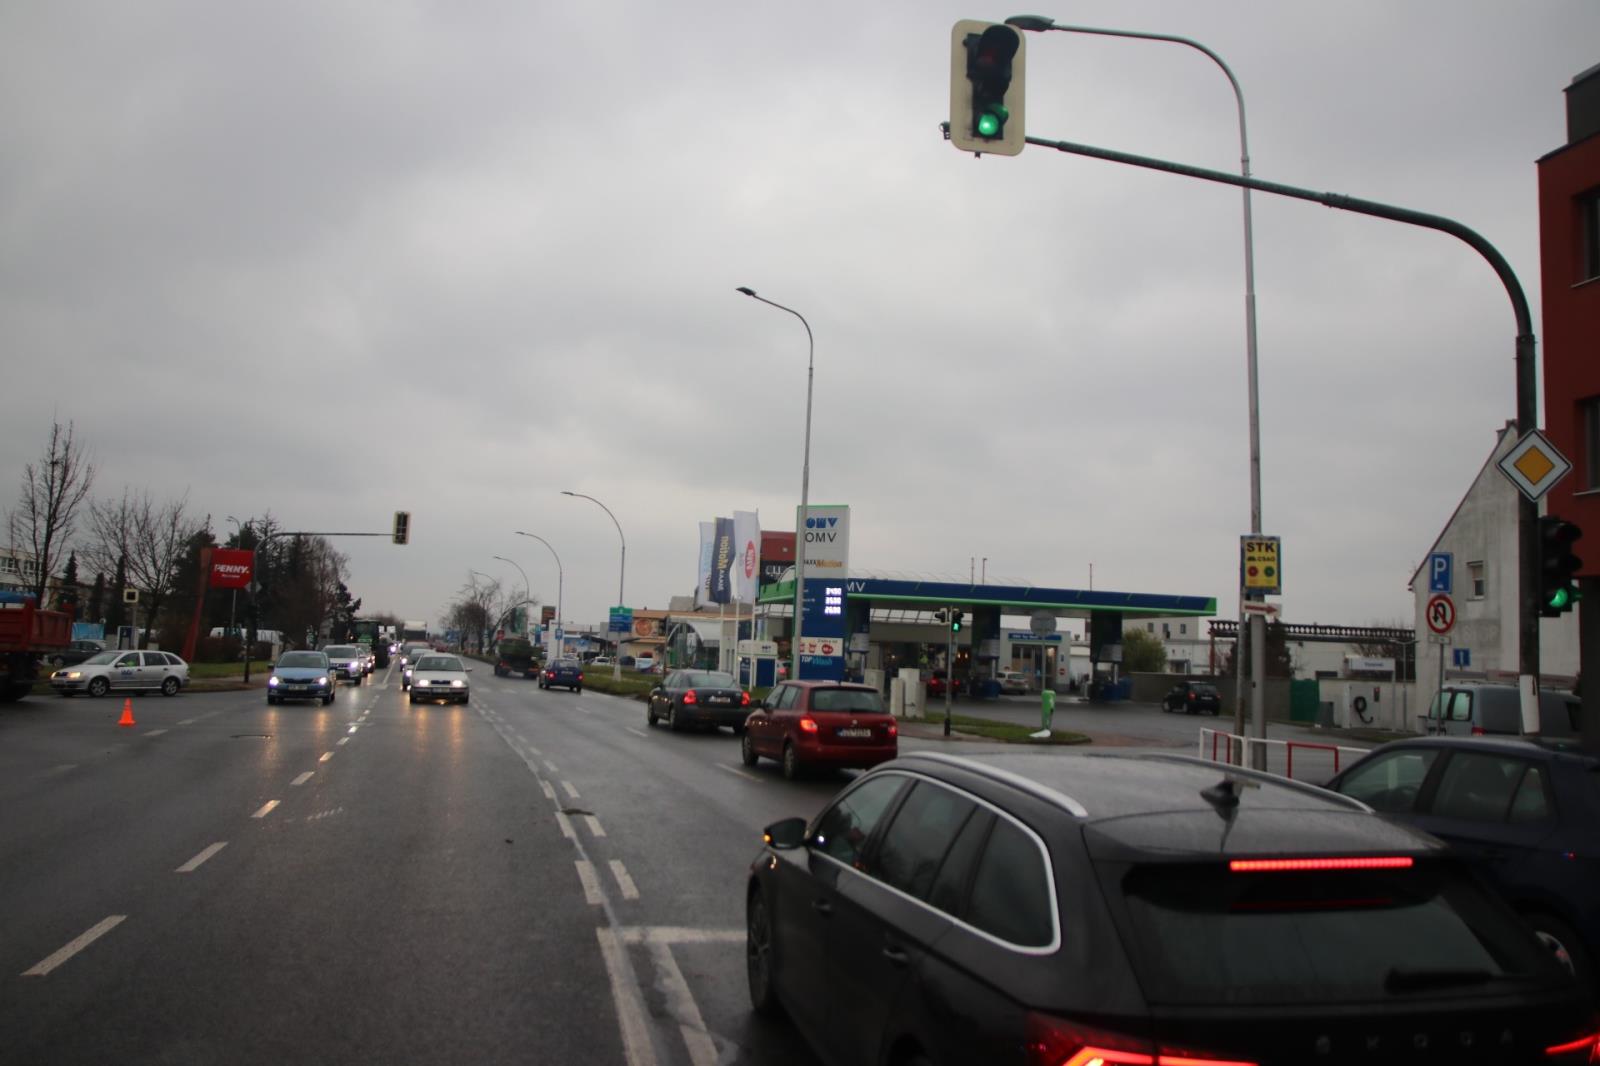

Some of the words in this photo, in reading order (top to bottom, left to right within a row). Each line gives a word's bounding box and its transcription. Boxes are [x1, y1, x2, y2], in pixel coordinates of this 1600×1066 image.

[805, 532, 837, 543] OMV
[1246, 542, 1275, 552] STK
[1434, 557, 1447, 580] P
